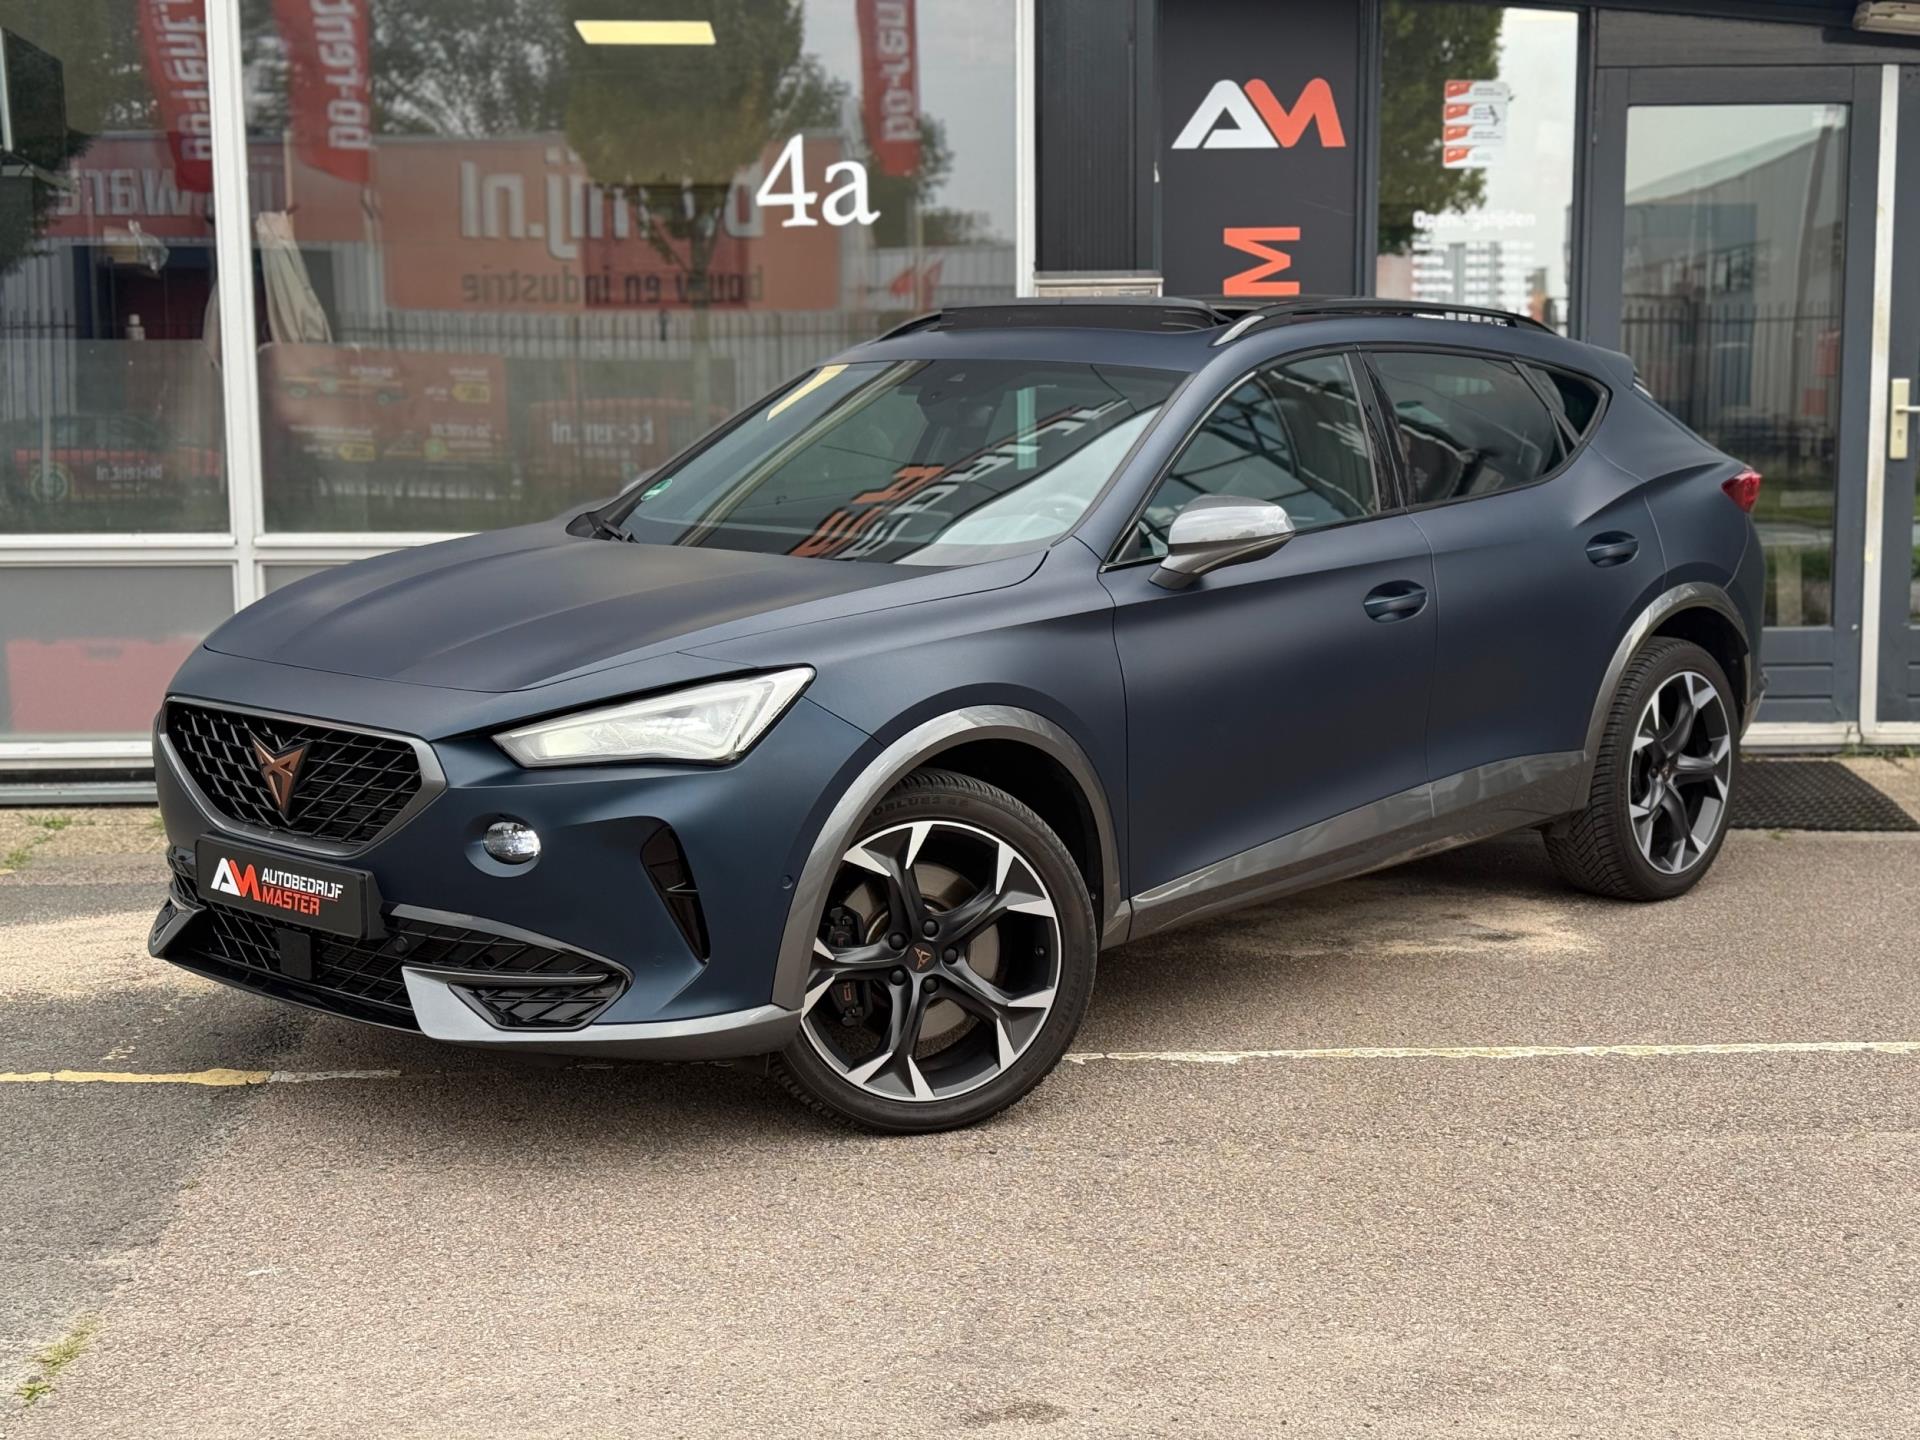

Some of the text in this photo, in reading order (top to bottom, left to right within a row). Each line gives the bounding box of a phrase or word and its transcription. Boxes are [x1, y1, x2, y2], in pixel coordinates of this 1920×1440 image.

[1172, 77, 1347, 150] AM
[755, 132, 881, 228] 4a
[210, 857, 262, 902] AM
[261, 867, 344, 899] AUTOBEDRIJF
[261, 887, 320, 916] MASTER
